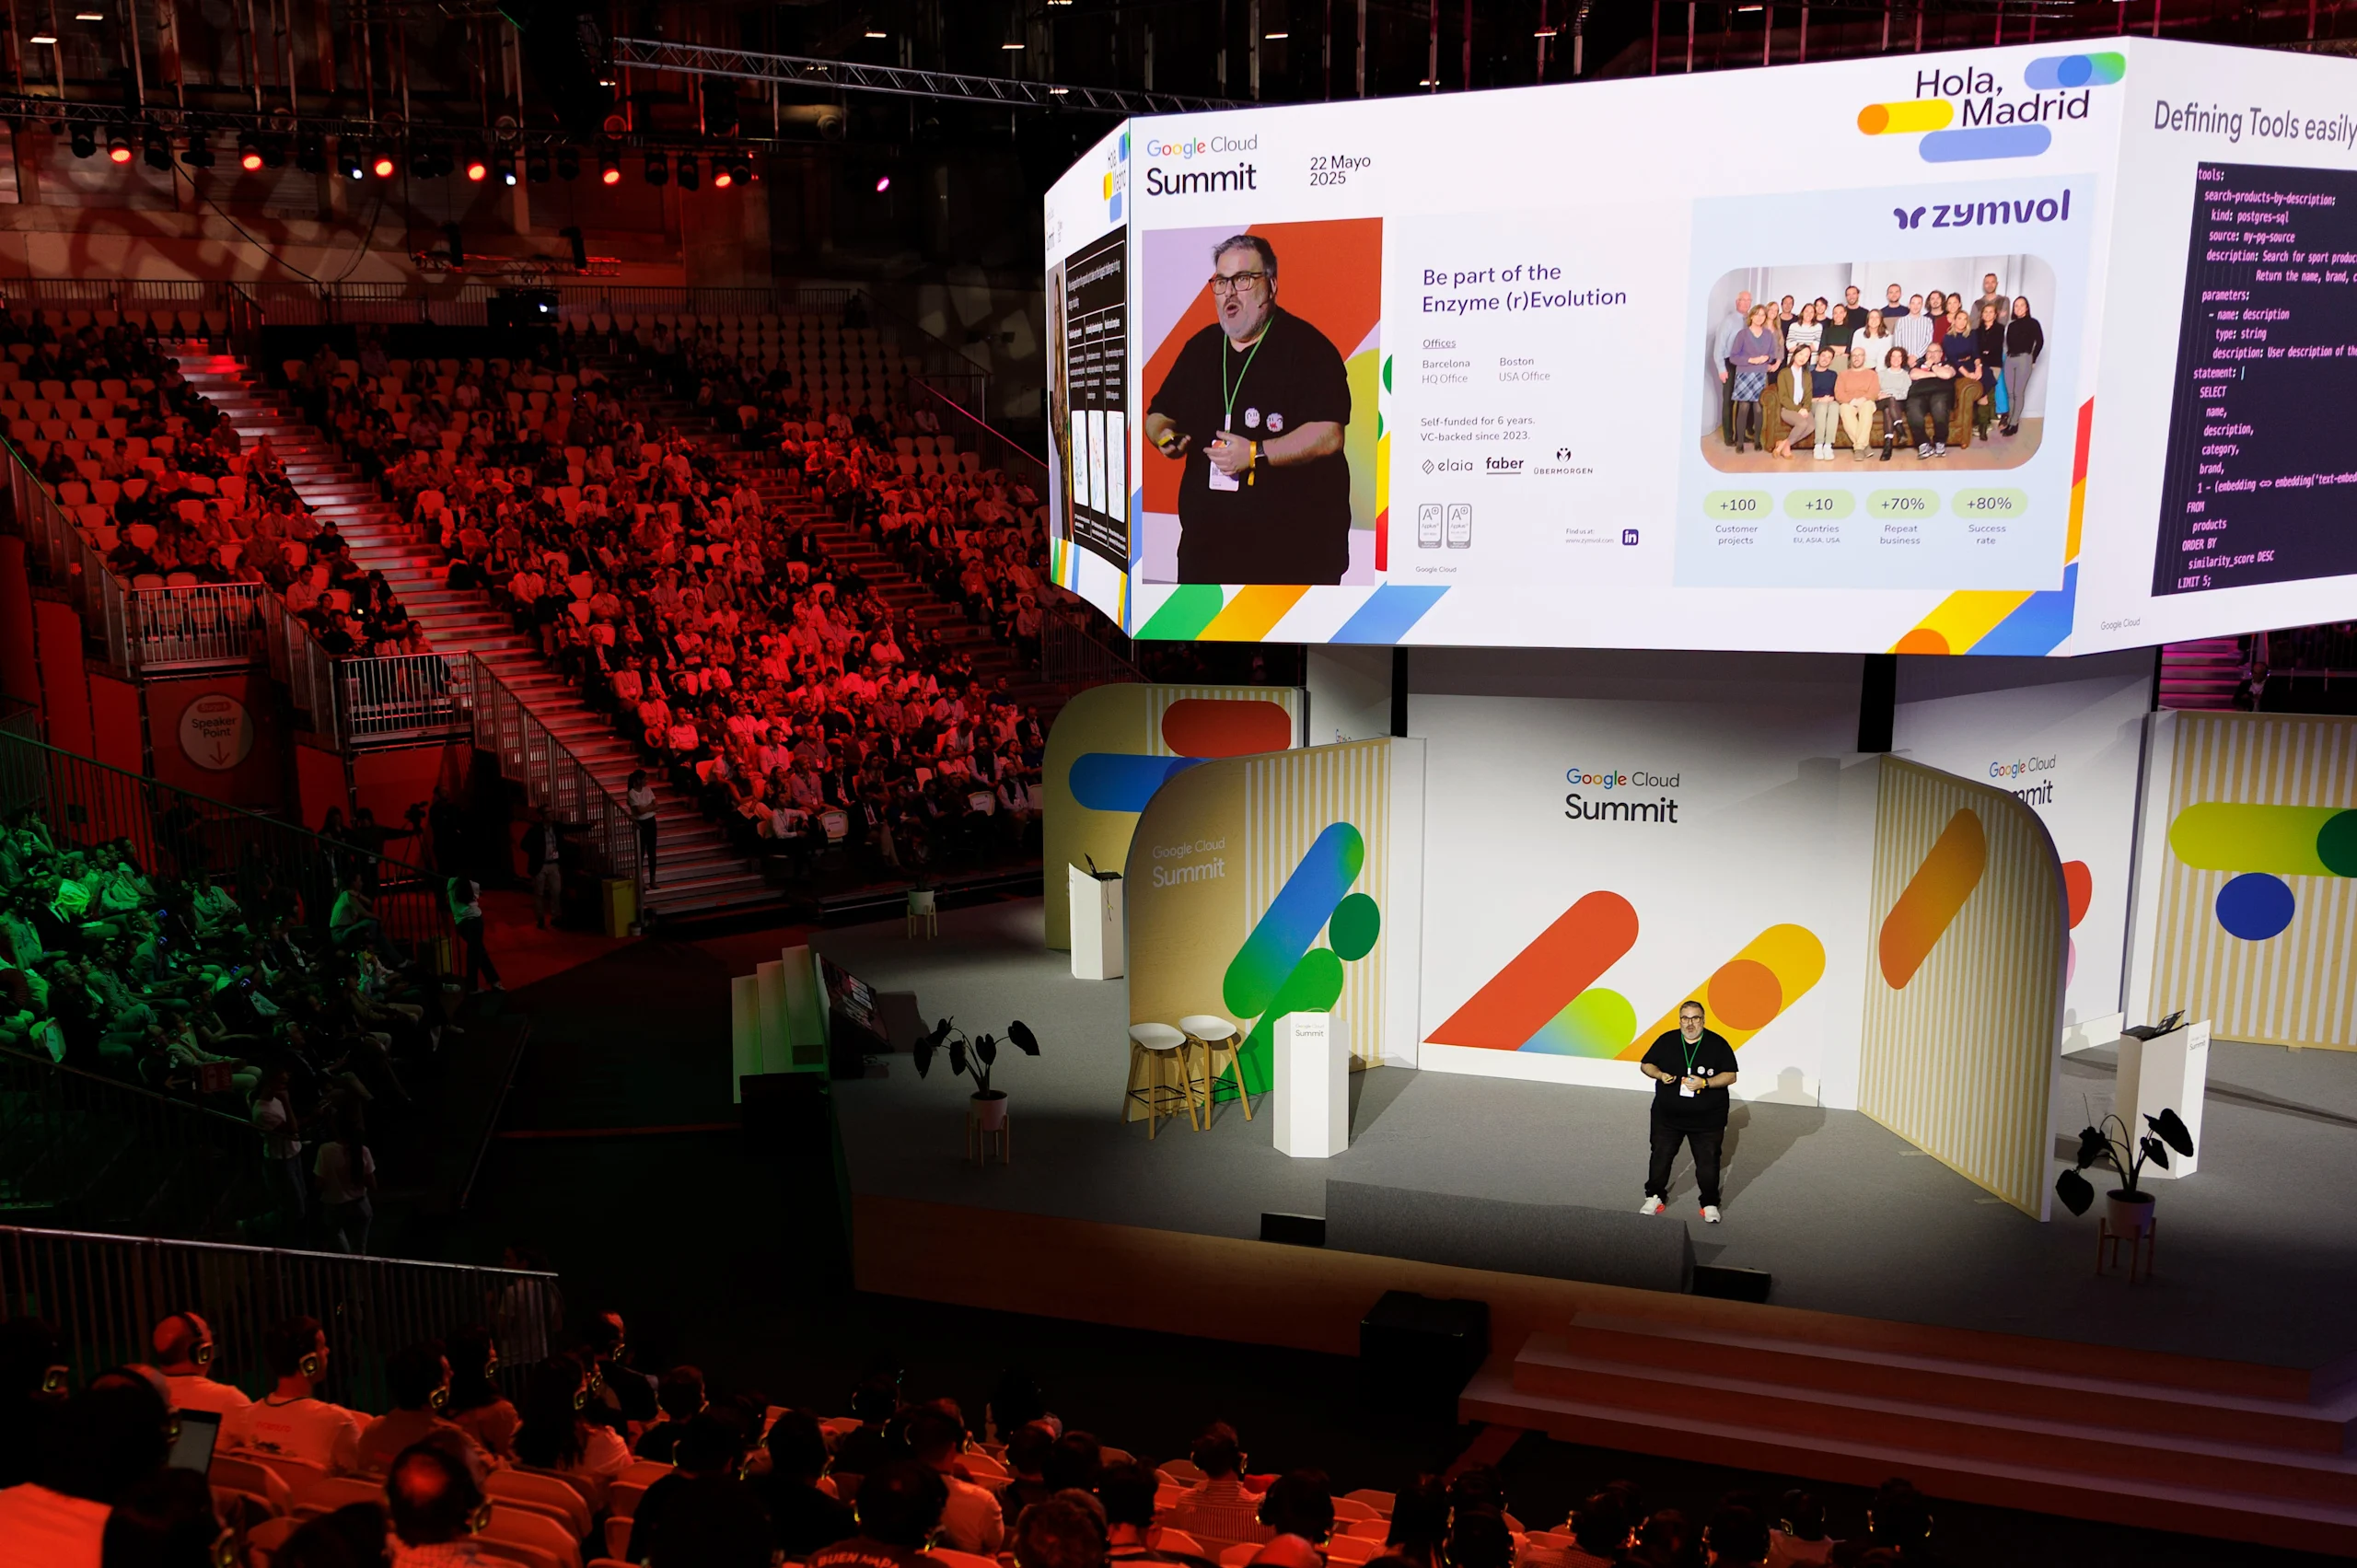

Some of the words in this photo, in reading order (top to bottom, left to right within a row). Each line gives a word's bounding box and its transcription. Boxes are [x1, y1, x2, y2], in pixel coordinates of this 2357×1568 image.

[1916, 66, 2003, 99] Hola,
[1962, 89, 2090, 127] Madrid
[2154, 99, 2243, 144] Defining
[2250, 107, 2299, 139] Tools
[2305, 113, 2357, 150] easily
[1147, 137, 1205, 159] Google
[1211, 134, 1258, 153] Cloud
[1310, 157, 1327, 170] 22
[1331, 155, 1371, 171] Mayo
[1146, 162, 1257, 196] Summit
[1309, 171, 1346, 186] 2025
[2198, 168, 2224, 181] tools:
[2204, 189, 2336, 207] search-products-by-description:
[1933, 189, 2071, 228] zymvol
[2212, 209, 2233, 222] kind:
[2236, 210, 2289, 226] postgres-sql
[2209, 231, 2239, 242] source:
[2243, 231, 2295, 246] my-pg-source
[2207, 249, 2258, 264] description:
[2263, 250, 2288, 262] Search
[2293, 250, 2305, 262] for
[2308, 252, 2328, 265] sport
[1423, 269, 1447, 285] Be
[1453, 267, 1495, 289] part
[1502, 264, 1523, 283] of
[1528, 263, 1562, 281] the
[2256, 270, 2282, 282] Return
[2286, 271, 2299, 282] the
[2301, 272, 2322, 284] name,
[2326, 270, 2349, 284] brand,
[1422, 296, 1500, 316] Enzyme
[1506, 288, 1627, 311] (r)Evolution
[2201, 290, 2250, 303] parameters:
[2217, 310, 2239, 321] name:
[2243, 308, 2290, 322] description
[2215, 329, 2236, 342] type:
[2241, 327, 2267, 342] string
[1422, 338, 1457, 349] Offices
[2212, 347, 2264, 361] description:
[2267, 346, 2285, 358] User
[2288, 345, 2333, 359] description
[2335, 344, 2345, 357] of
[1422, 359, 1470, 369] Barcelona
[1500, 357, 1535, 367] Boston
[1422, 374, 1438, 385] HQ
[1440, 373, 1469, 384] Office
[1499, 372, 1519, 382] USA
[1522, 371, 1550, 382] Office
[2193, 367, 2236, 379] statement:
[2200, 386, 2227, 399] SELECT
[2206, 407, 2227, 418] name,
[1421, 416, 1478, 427] Self-funded
[1480, 416, 1494, 426] for
[1497, 416, 1504, 426] 6
[1506, 417, 1536, 427] years.
[1421, 432, 1472, 442] VC-backed
[1475, 432, 1500, 442] since
[1503, 431, 1531, 442] 2023.
[2203, 423, 2254, 437] description,
[2201, 444, 2239, 458] category,
[1437, 459, 1473, 472] elaia
[1486, 457, 1525, 470] faber
[2200, 462, 2224, 475] brand,
[1533, 467, 1594, 475] ÜBERMORGEN
[2198, 482, 2202, 494] 1
[2214, 478, 2257, 494] (embedding
[1720, 498, 1756, 512] +100
[1805, 497, 1833, 512] +10
[1881, 497, 1925, 511] +70%
[1967, 496, 2013, 511] +80%
[2187, 501, 2205, 514] FROM
[1715, 524, 1759, 534] Customer
[1795, 524, 1840, 533] Countries
[1884, 524, 1918, 535] Repeat
[1968, 523, 2006, 533] Success
[2192, 519, 2227, 534] products
[1718, 536, 1754, 546] projects
[1880, 535, 1921, 545] business
[1976, 537, 1996, 545] rate
[2182, 539, 2204, 552] ORDER
[2207, 537, 2217, 550] BY
[2188, 553, 2255, 570] similarity_score
[2257, 550, 2275, 563] DESC
[1416, 566, 1437, 575] Google
[2177, 576, 2200, 589] LIMIT
[2100, 619, 2122, 632] Google
[2123, 617, 2141, 629] Cloud
[192, 717, 238, 730] Speaker
[203, 727, 231, 738] Point
[1990, 759, 2026, 779] Google
[2028, 754, 2057, 772] Cloud
[1566, 768, 1627, 790] Google
[1631, 772, 1680, 788] Cloud
[2013, 779, 2053, 807] mmit
[1564, 793, 1678, 824] Summit
[1152, 842, 1192, 861] Google
[1195, 836, 1225, 853] Cloud
[1152, 857, 1225, 889] Summit
[1295, 1029, 1324, 1038] Summit
